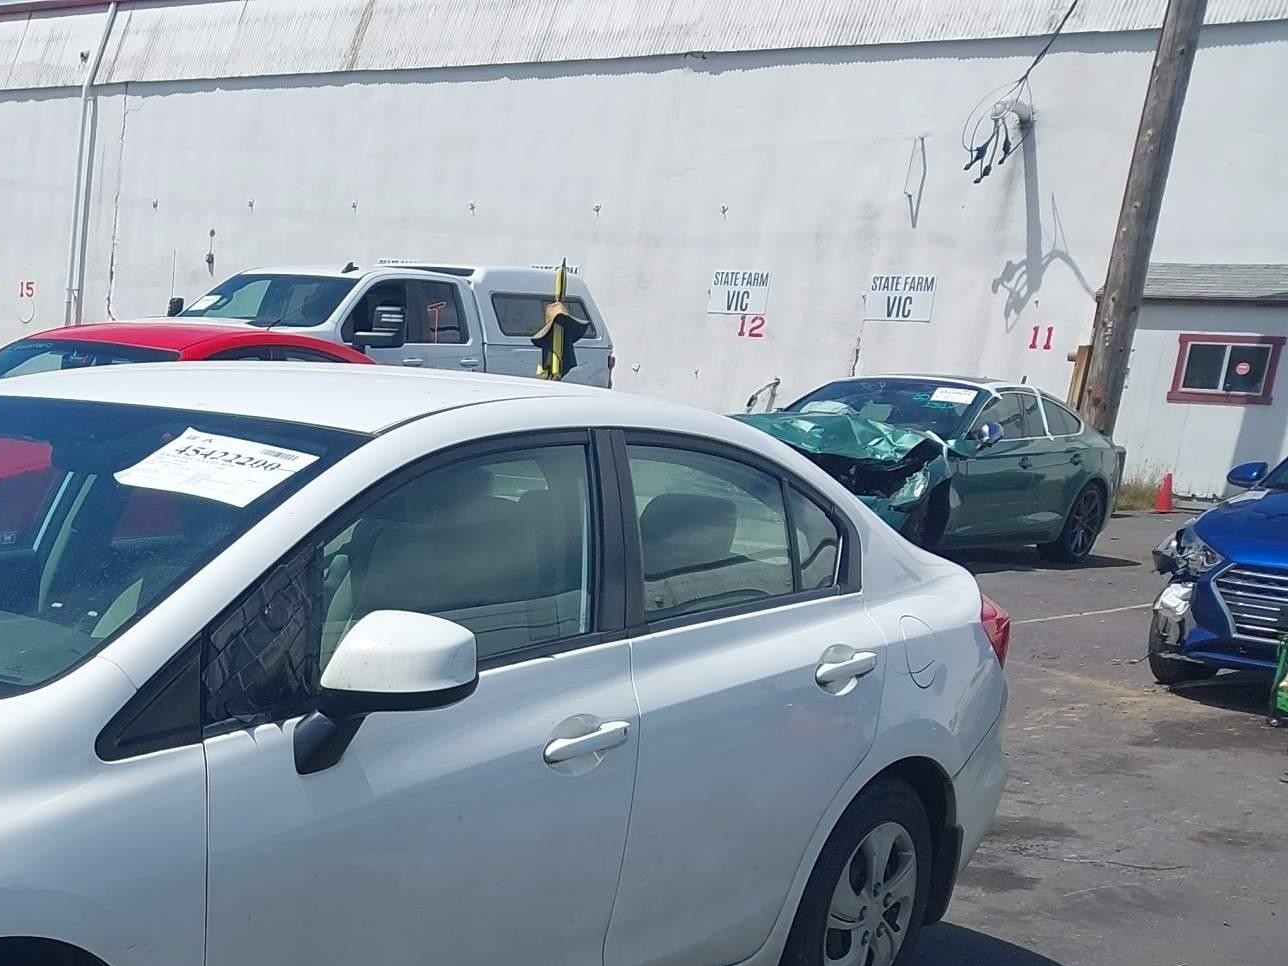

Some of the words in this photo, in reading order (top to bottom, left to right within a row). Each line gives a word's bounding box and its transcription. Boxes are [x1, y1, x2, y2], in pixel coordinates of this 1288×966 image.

[19, 281, 35, 298] 15
[713, 271, 740, 287] STATE
[740, 272, 770, 287] FARM
[871, 276, 902, 292] STATE
[903, 276, 936, 293] FARM
[726, 290, 750, 312] VIC
[886, 296, 913, 318] VIC
[738, 315, 766, 338] 12
[1029, 325, 1054, 351] 11
